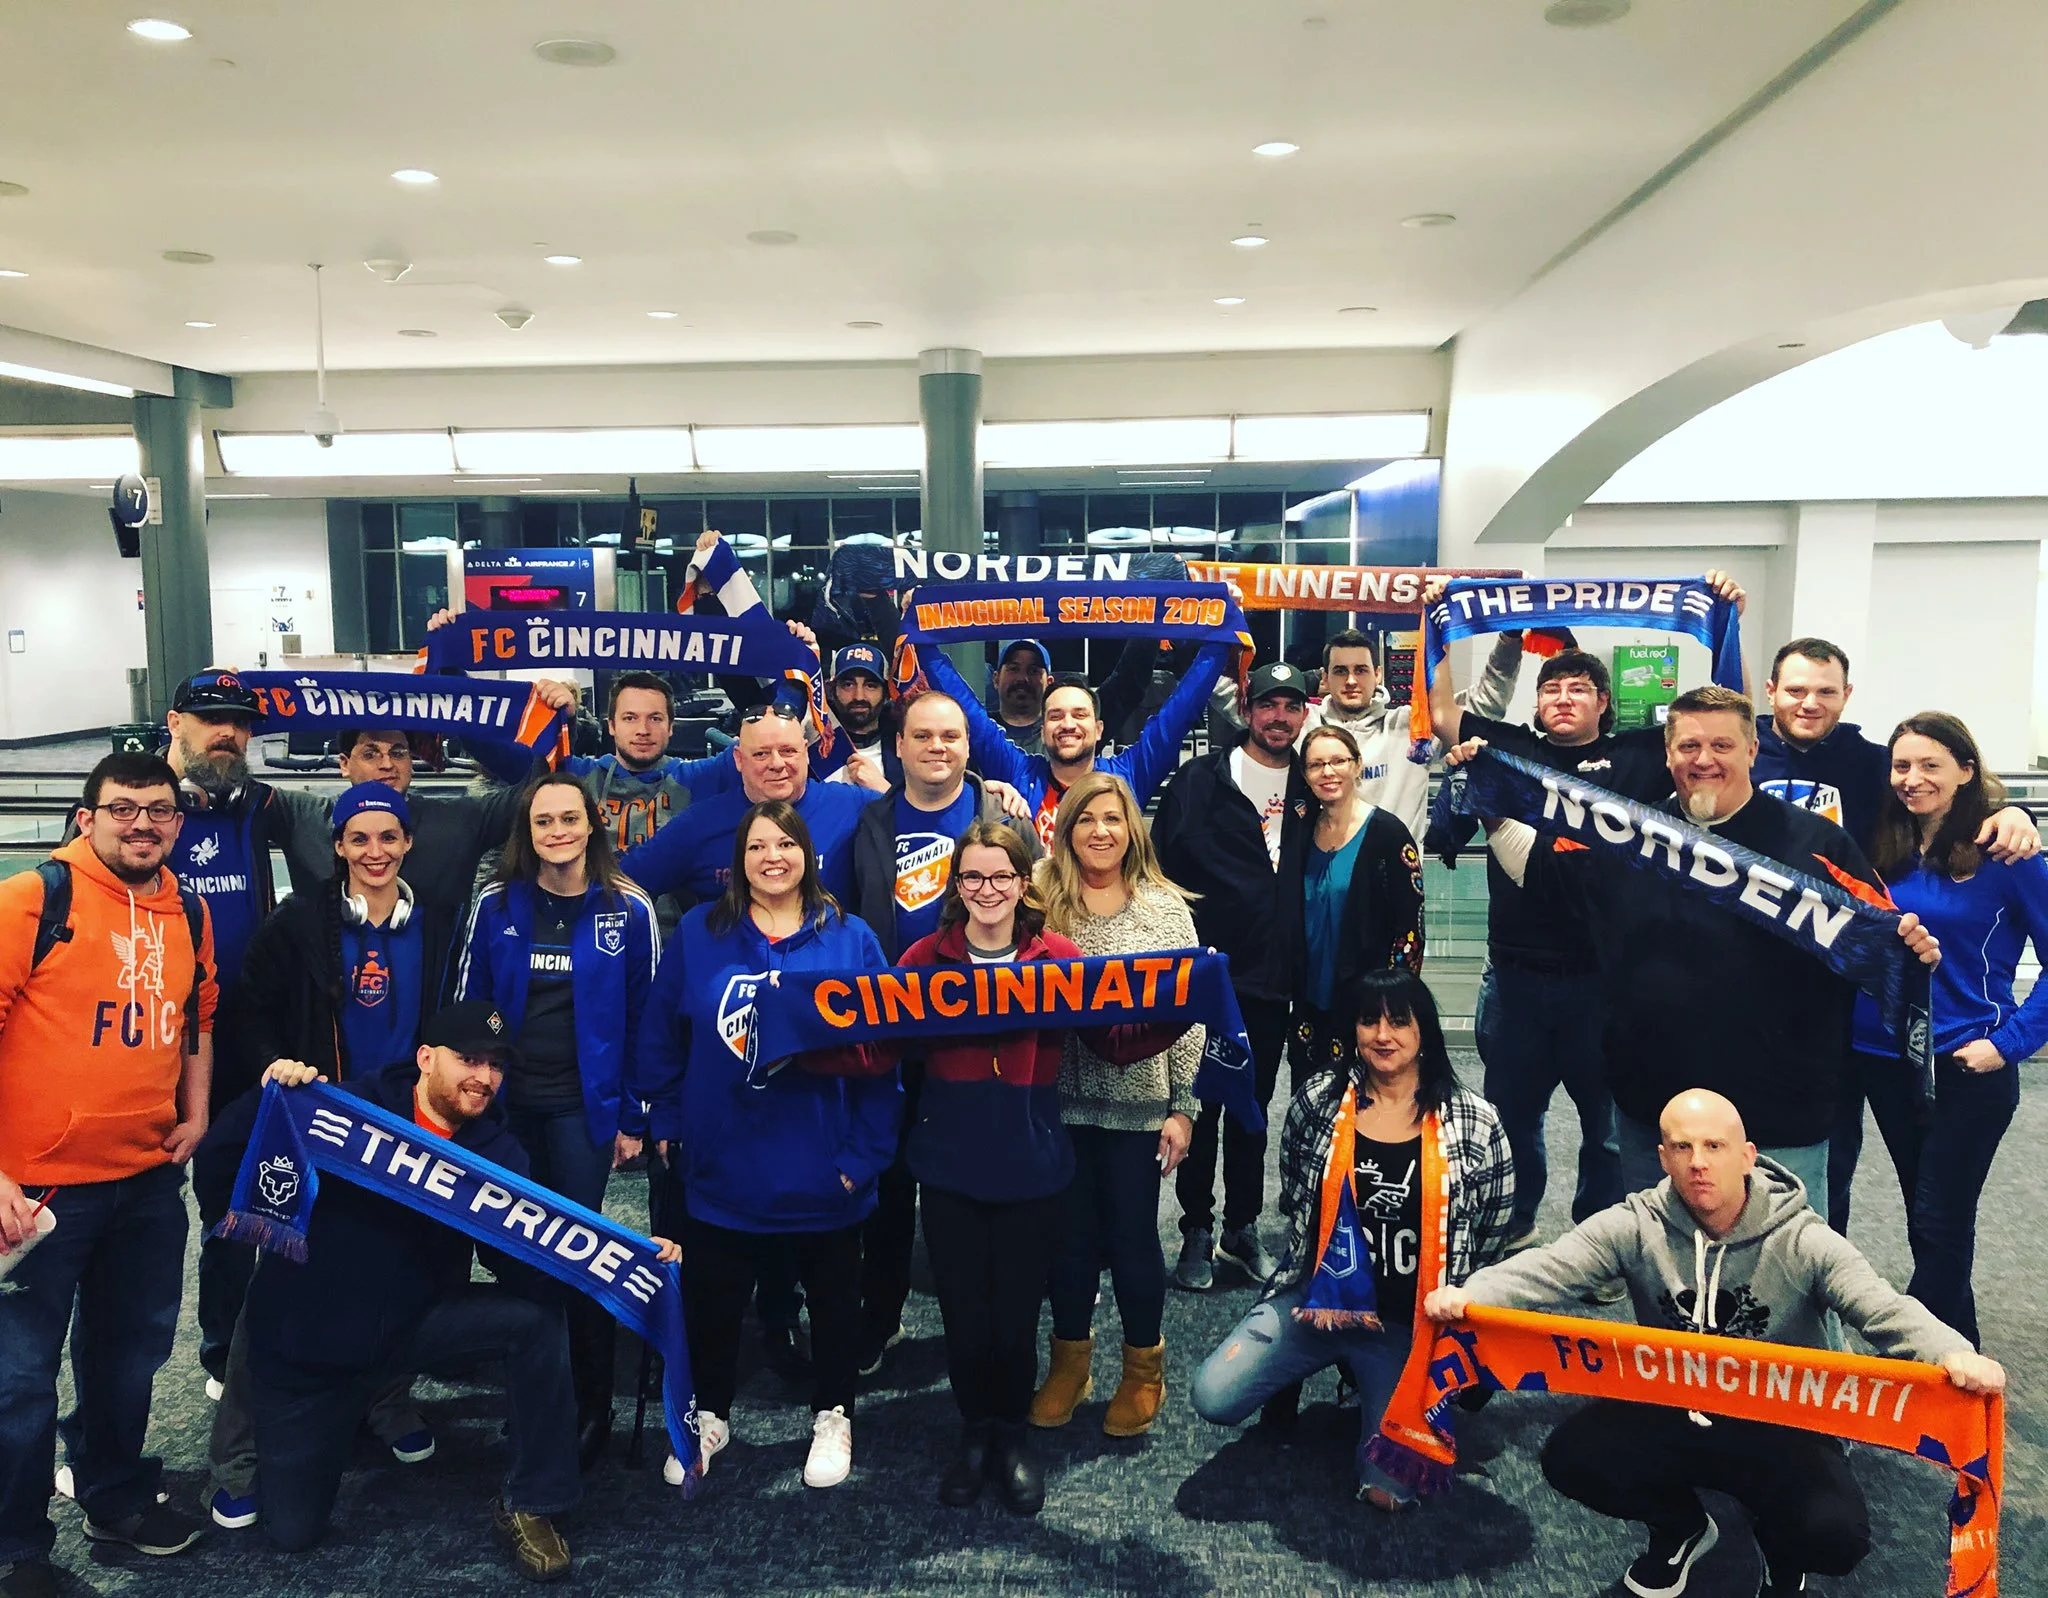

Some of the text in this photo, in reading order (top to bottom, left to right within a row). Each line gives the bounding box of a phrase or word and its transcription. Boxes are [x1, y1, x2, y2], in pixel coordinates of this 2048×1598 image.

[133, 490, 143, 510] 7
[893, 548, 1131, 582] NORDEN
[278, 586, 286, 597] 7
[576, 592, 587, 607] 7
[1450, 582, 1682, 620] THE PRIDE
[915, 596, 1227, 631] INAUGURAL SEASON 2019
[471, 626, 743, 666] FC CINCINNATI
[301, 687, 511, 727] CINCINNATI
[896, 841, 910, 853] FC
[1542, 778, 1856, 948] NORDEN
[598, 920, 625, 929] PRIDE
[360, 975, 383, 990] FC
[738, 983, 757, 999] FC
[813, 957, 1195, 1028] CINCINNATI
[360, 1123, 634, 1284] THE PRIDE
[1551, 1334, 1913, 1422] FC CINCINNATI
